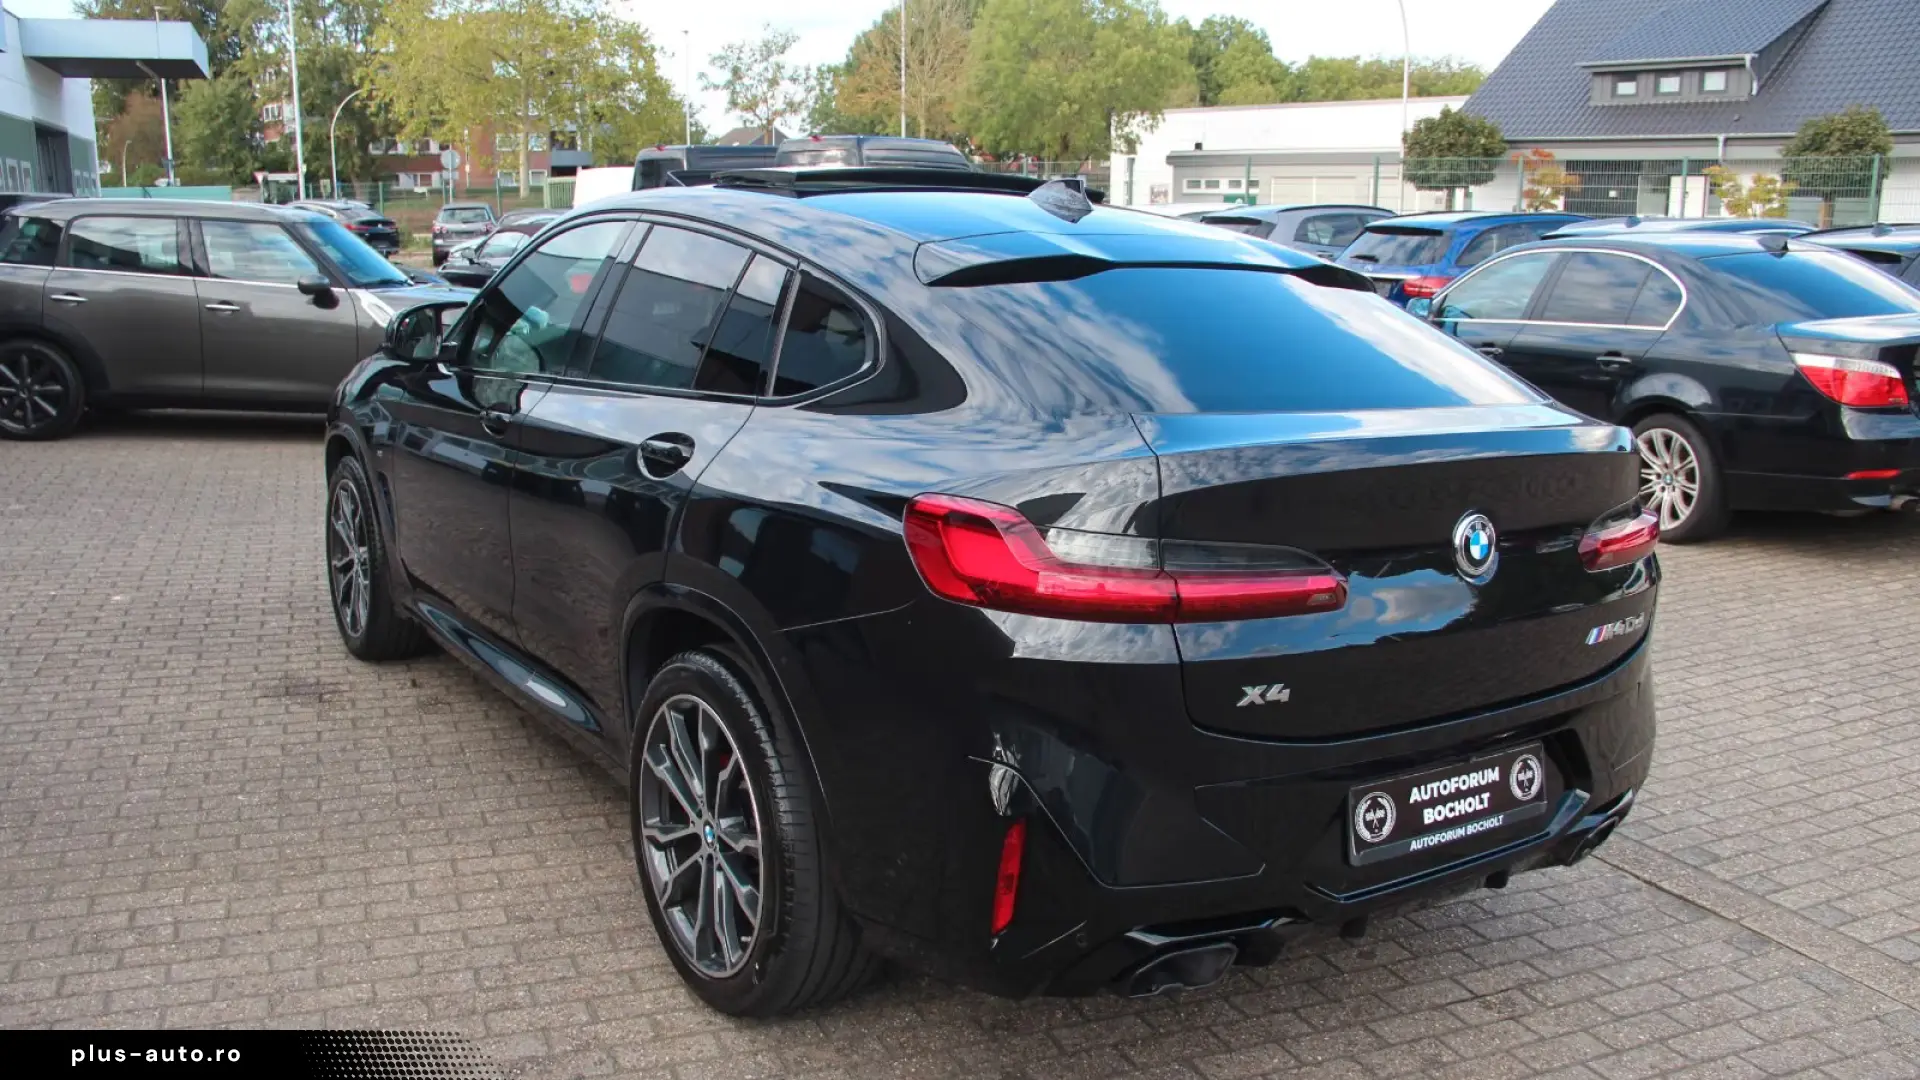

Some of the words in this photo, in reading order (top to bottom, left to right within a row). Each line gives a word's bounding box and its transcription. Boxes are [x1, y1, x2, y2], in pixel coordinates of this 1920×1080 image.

[1236, 683, 1291, 707] X4
[1409, 766, 1500, 804] AUTOFORUM
[1423, 792, 1490, 825] BOCHOLT
[1409, 828, 1465, 852] AUTOFORUM
[1466, 814, 1505, 835] BOCHOLT
